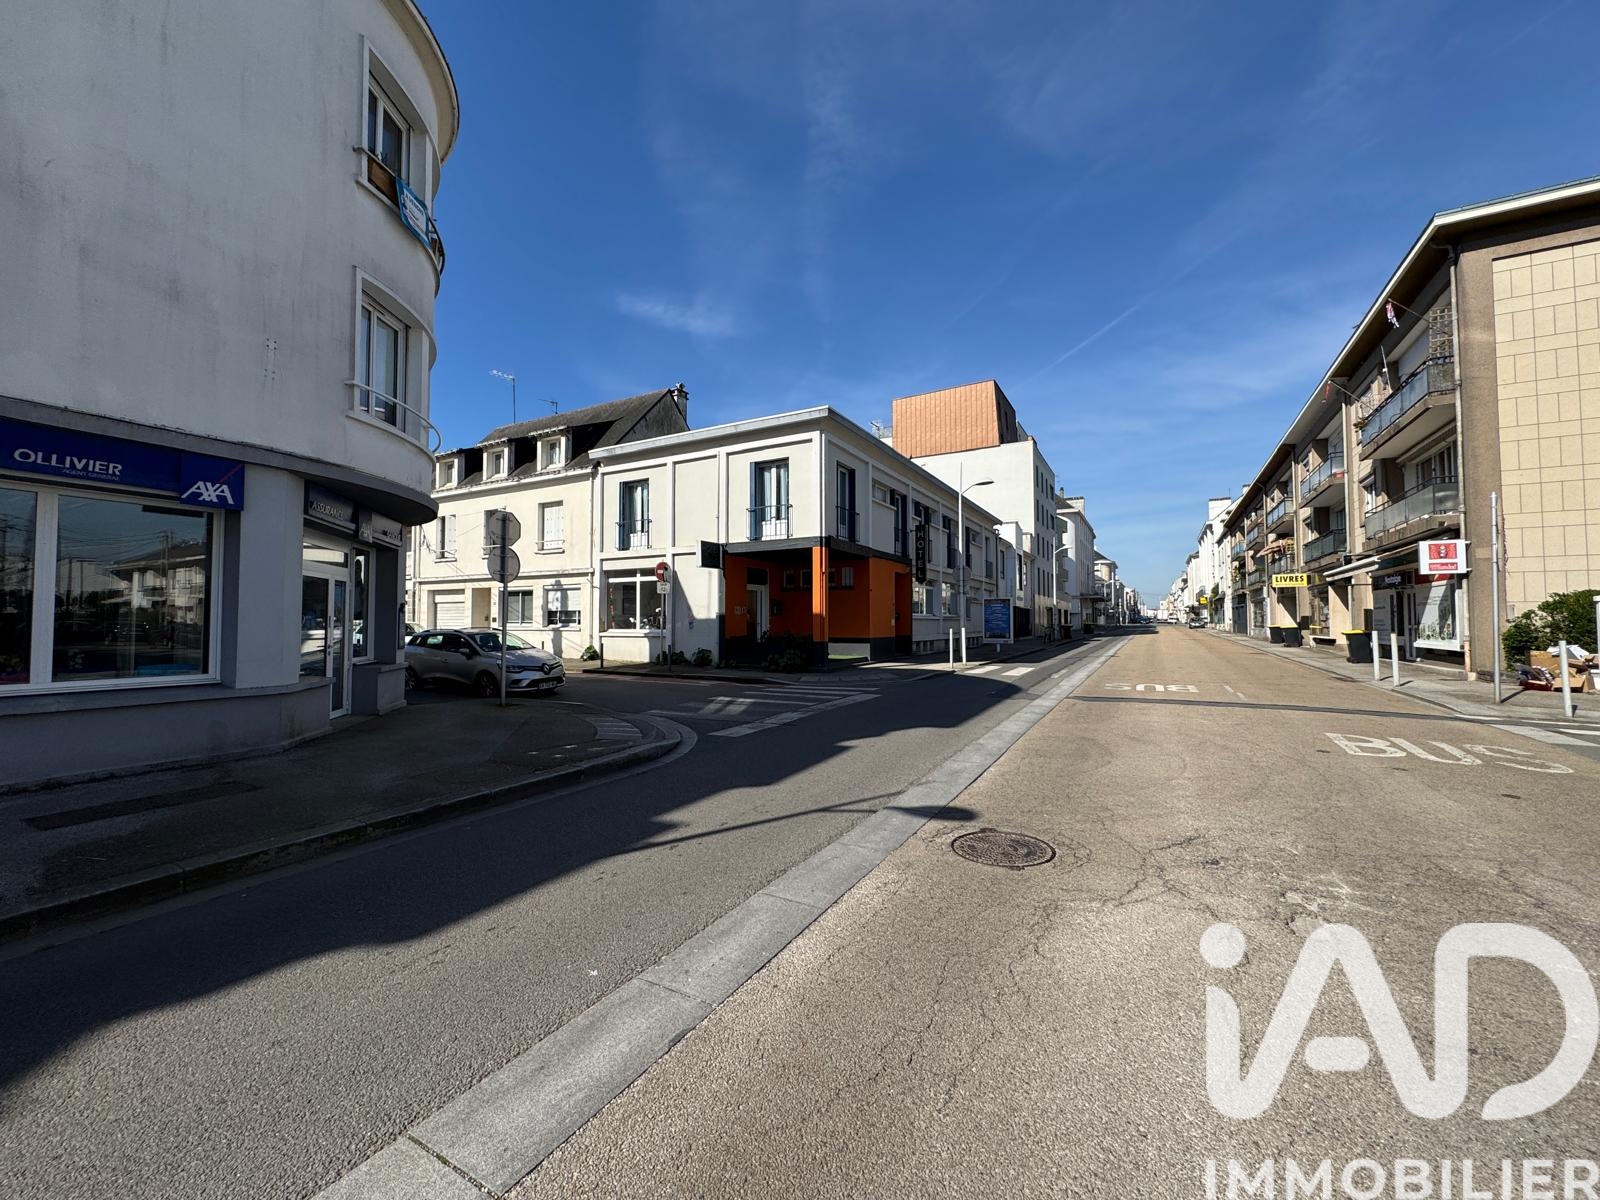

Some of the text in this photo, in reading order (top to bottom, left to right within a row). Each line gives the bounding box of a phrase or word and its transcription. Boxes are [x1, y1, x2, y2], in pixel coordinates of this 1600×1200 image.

[14, 448, 122, 475] OLLIVIER
[181, 481, 235, 505] AXA
[917, 531, 925, 578] HOTEL
[1275, 575, 1305, 583] LIVRES
[1104, 683, 1200, 693] BUS
[1324, 732, 1575, 774] BUS
